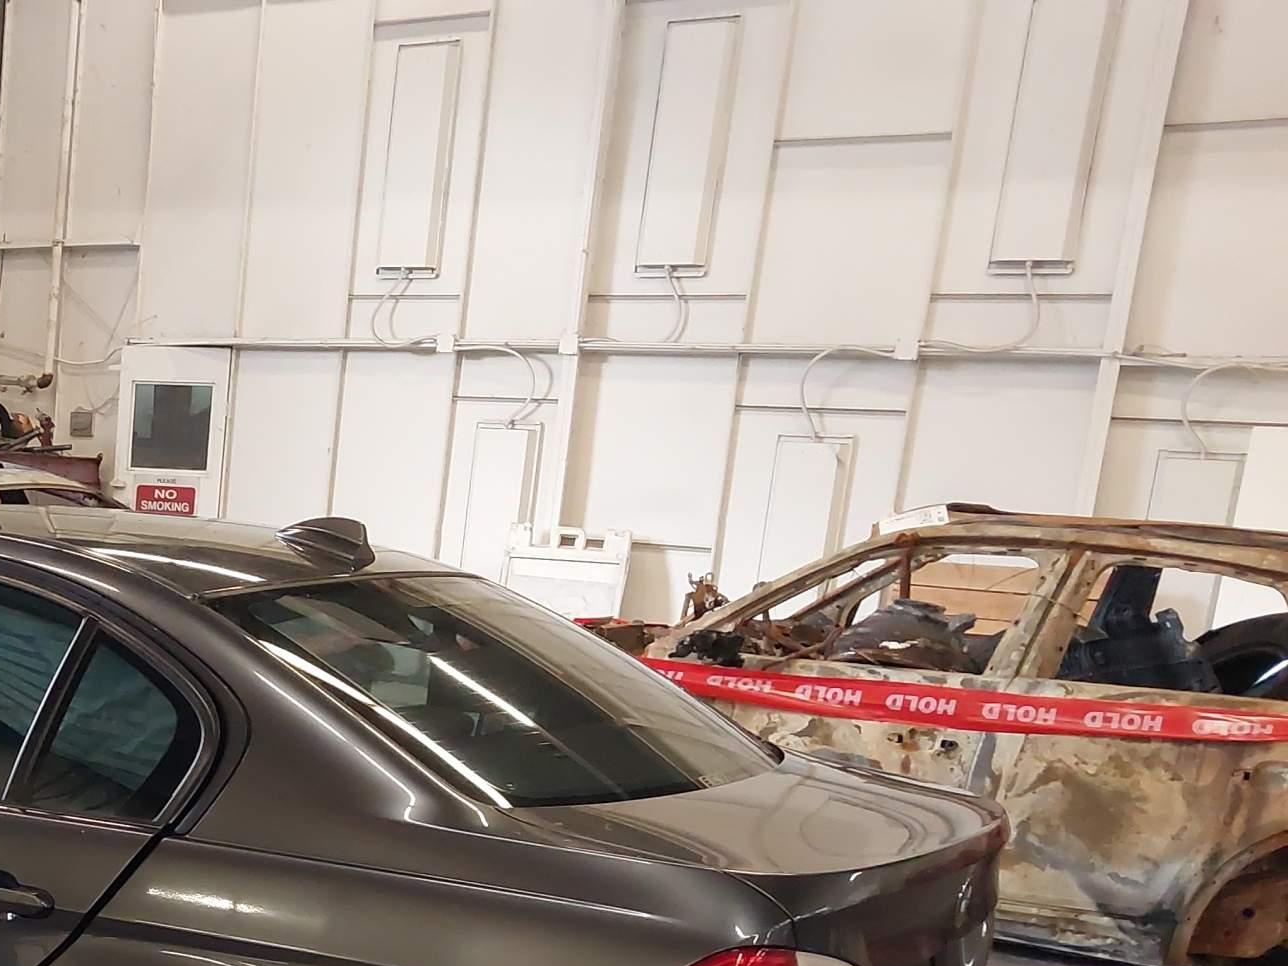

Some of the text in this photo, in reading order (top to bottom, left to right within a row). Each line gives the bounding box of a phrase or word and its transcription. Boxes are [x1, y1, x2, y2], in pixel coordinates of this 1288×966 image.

[154, 489, 177, 499] NO
[140, 500, 189, 512] SMOKING
[794, 684, 863, 706] HOLD
[885, 693, 958, 716] HOLD
[981, 702, 1058, 725] HOLD
[1083, 711, 1164, 732] HOLD
